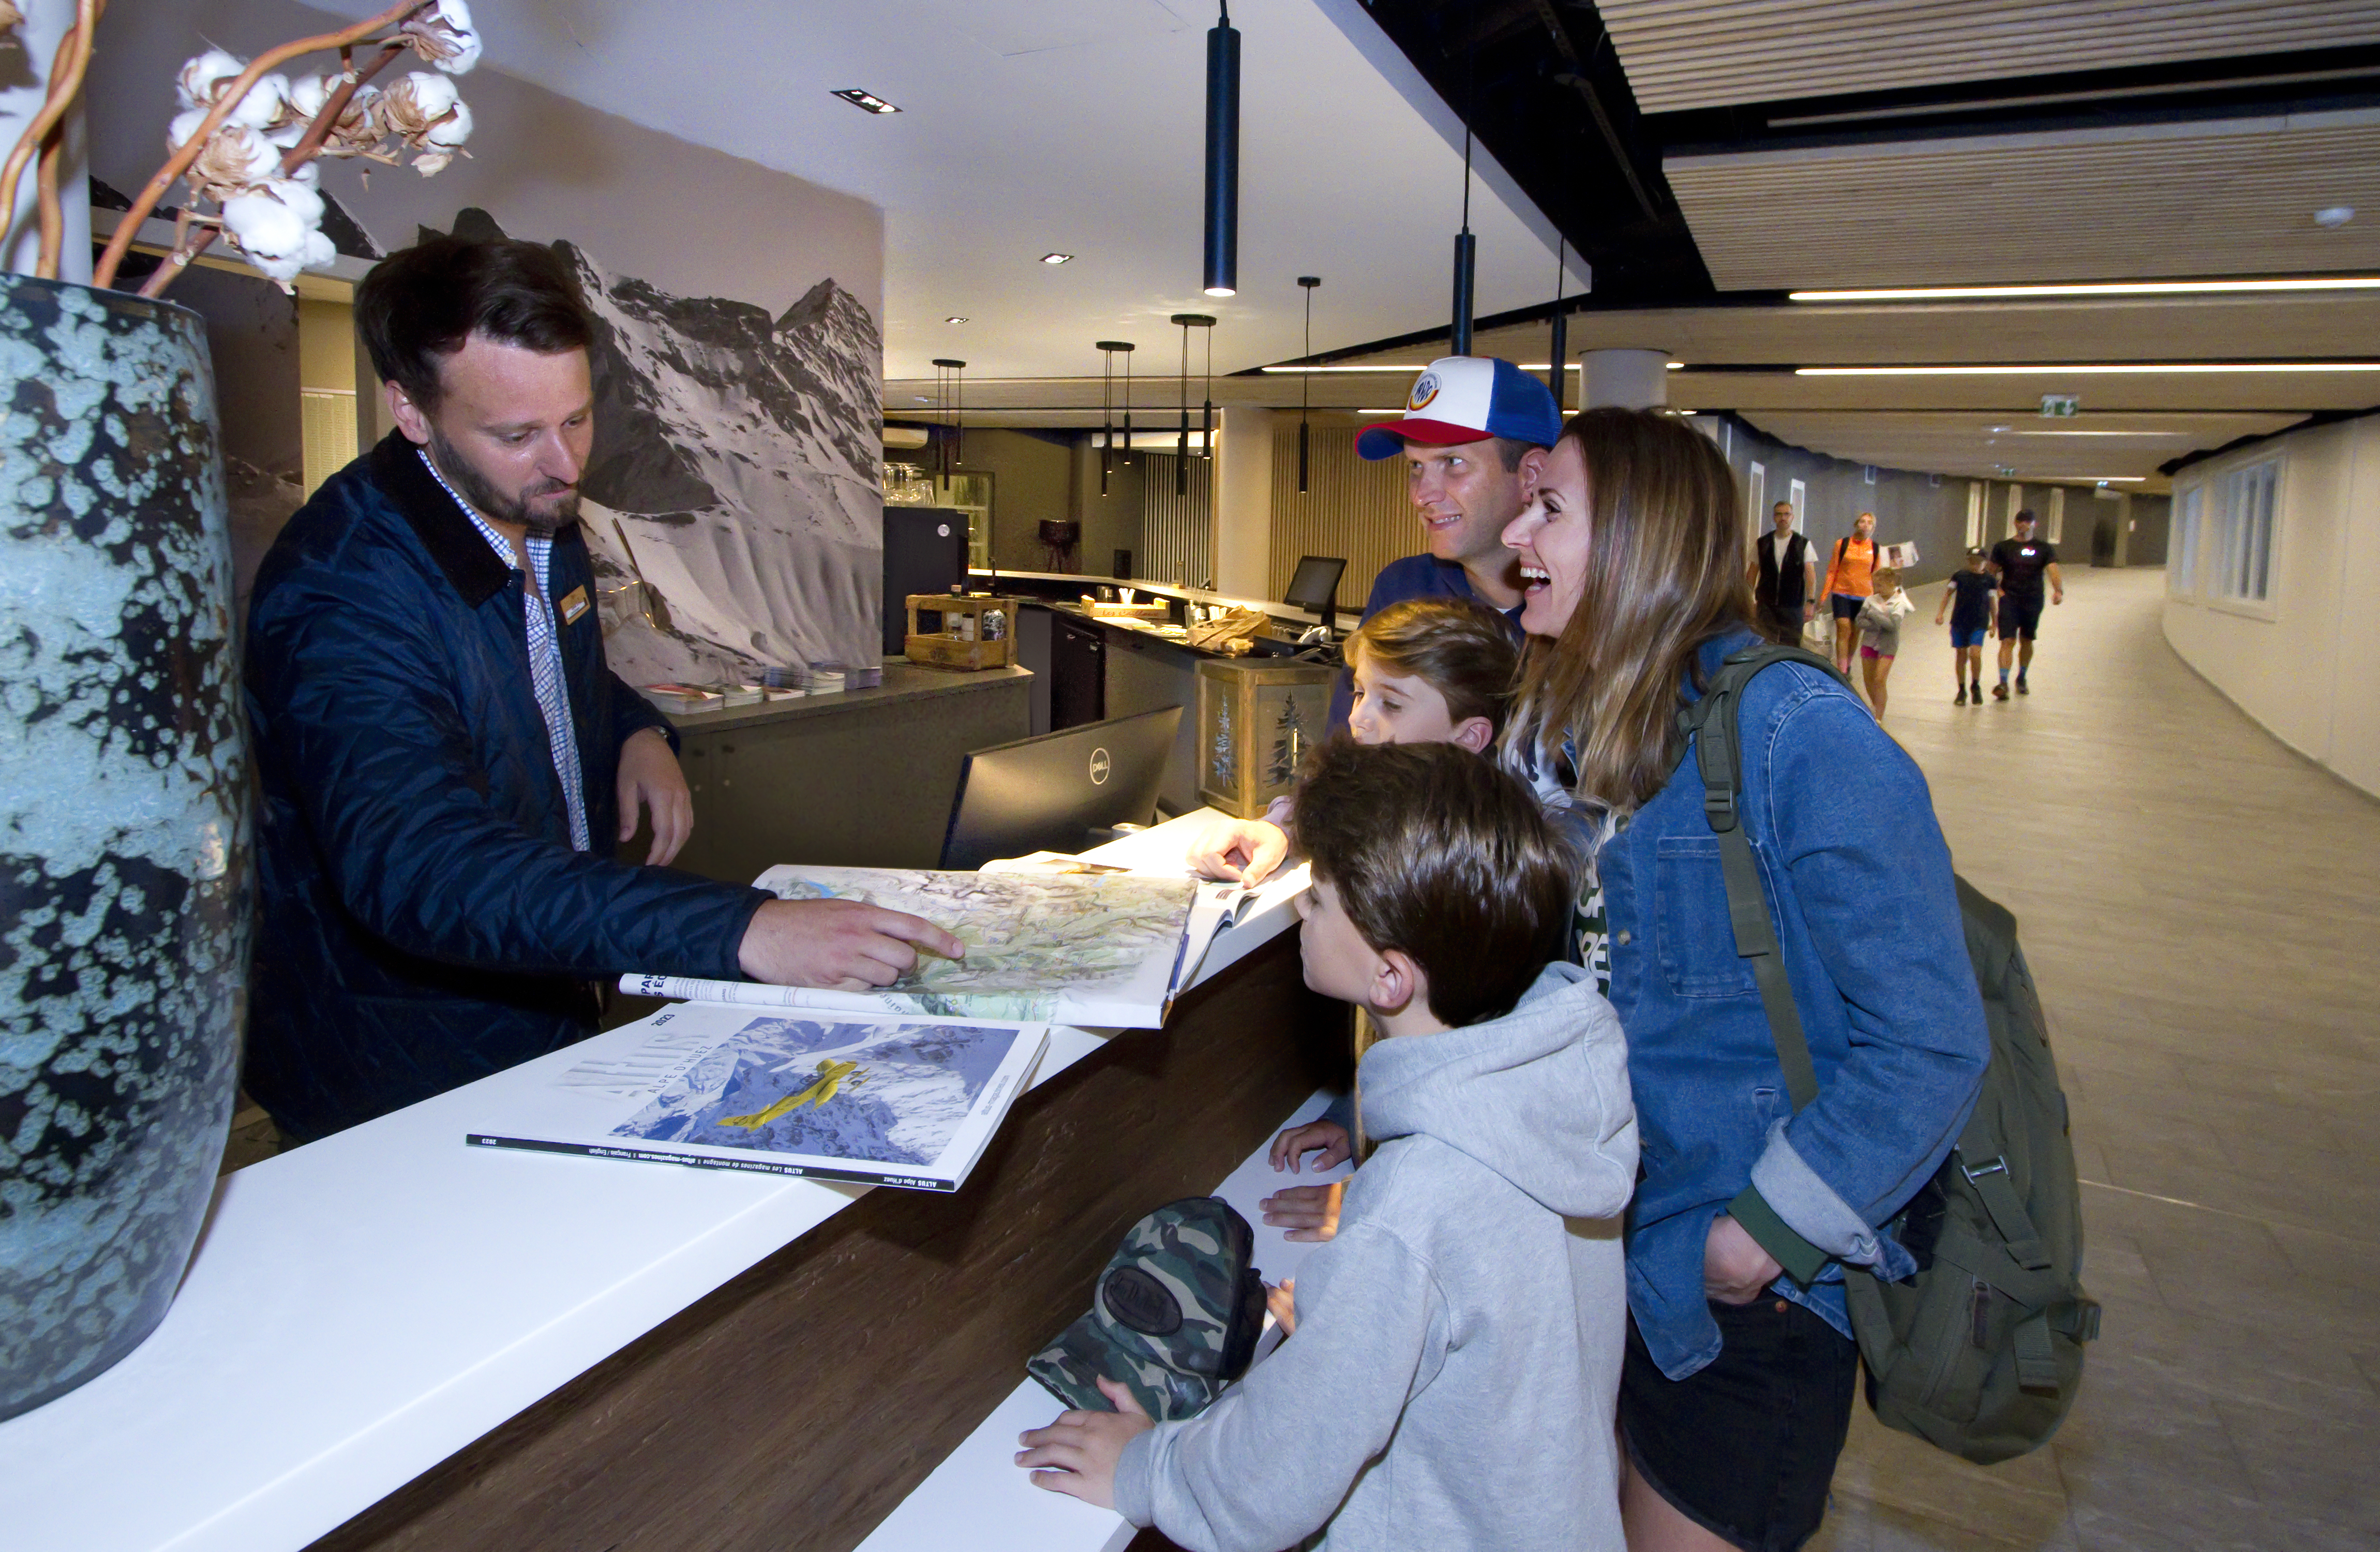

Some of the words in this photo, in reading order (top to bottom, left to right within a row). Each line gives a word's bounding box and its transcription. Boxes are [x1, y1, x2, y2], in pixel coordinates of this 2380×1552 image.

[1093, 760, 1108, 772] DELL
[651, 1013, 675, 1026] 2023
[648, 1074, 677, 1094] ALPE
[674, 1046, 713, 1071] D'HUEZ
[638, 1153, 696, 1164] altus-magazines.com
